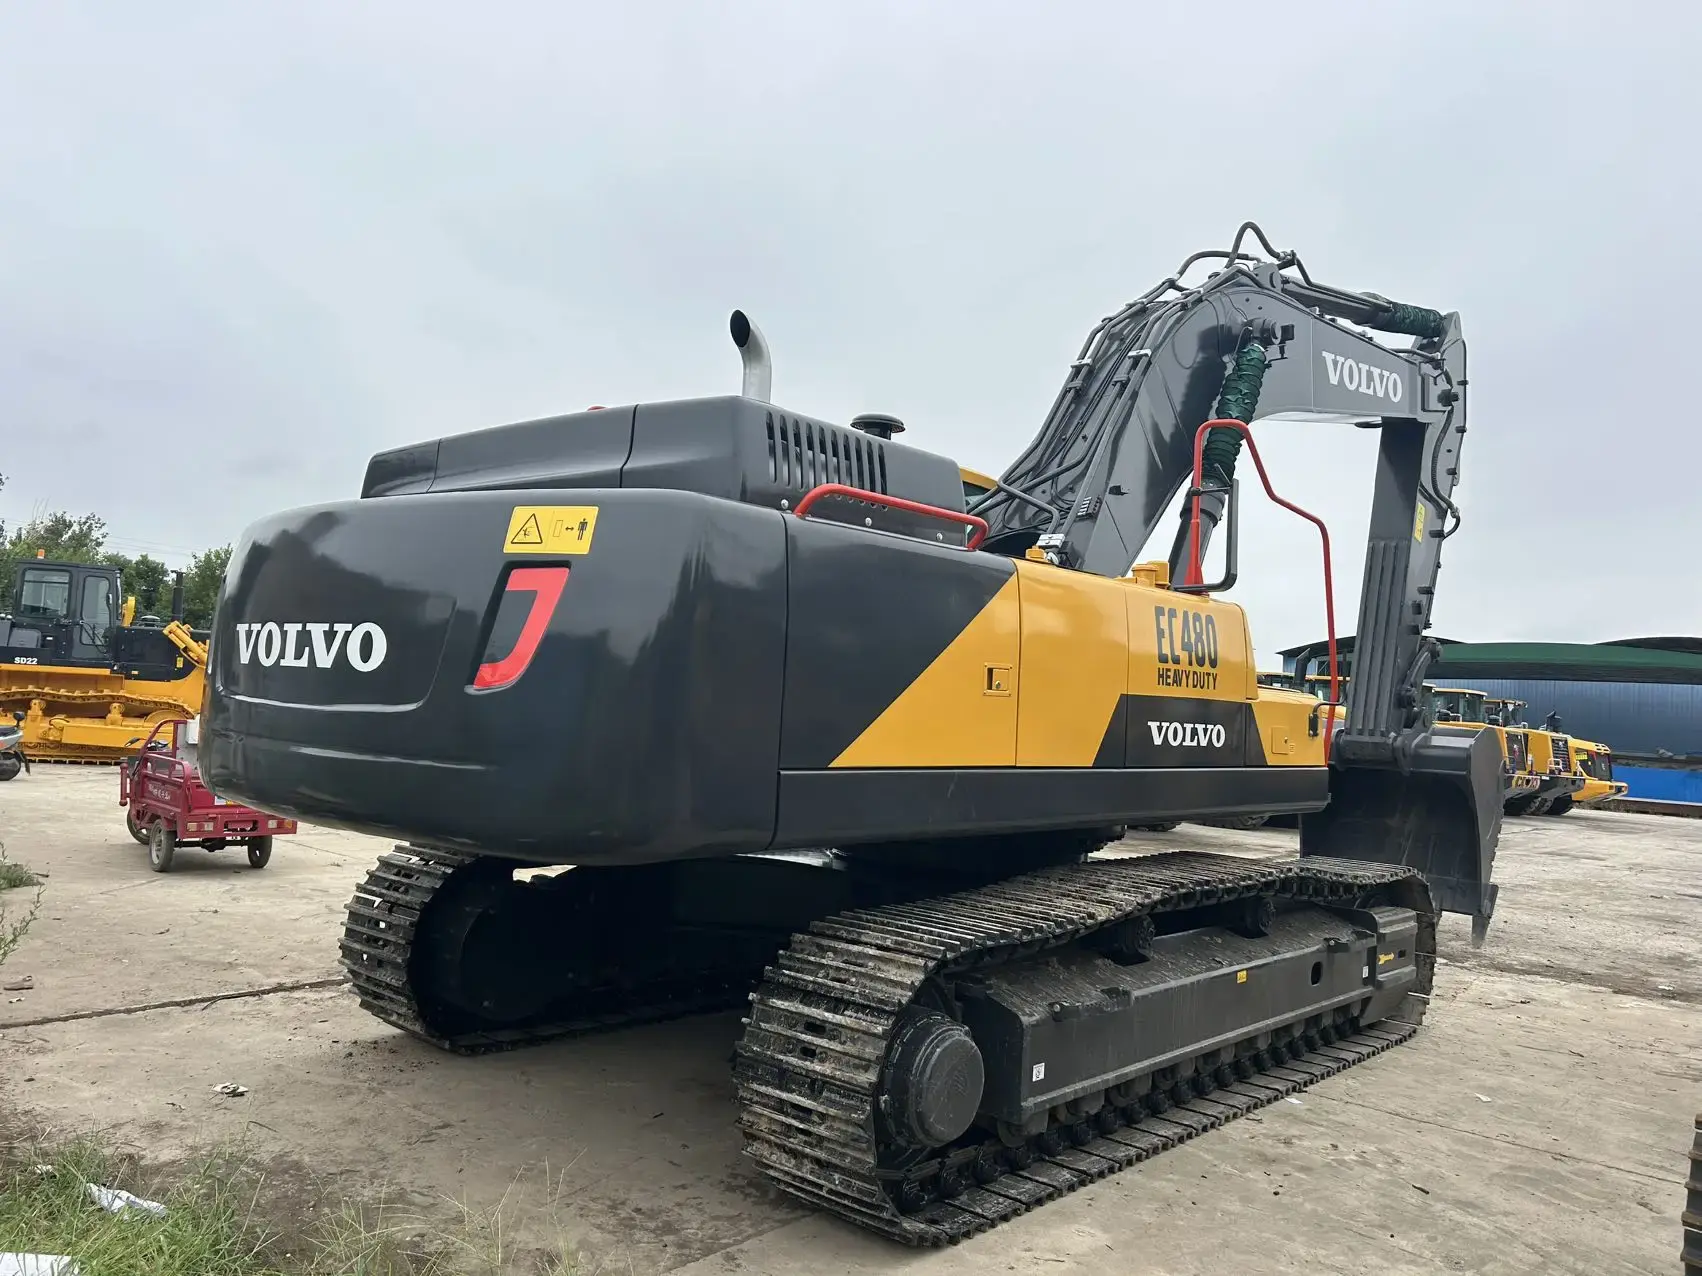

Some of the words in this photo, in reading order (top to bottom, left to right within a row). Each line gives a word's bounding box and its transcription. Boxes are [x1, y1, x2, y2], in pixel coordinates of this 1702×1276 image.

[1322, 351, 1402, 403] VOLVO
[236, 621, 388, 673] VOLVO
[1154, 605, 1218, 669] EC480
[14, 656, 38, 665] SD22
[1157, 667, 1191, 688] HEAVY
[1192, 670, 1218, 690] DUTY
[1147, 721, 1226, 748] VOLVO
